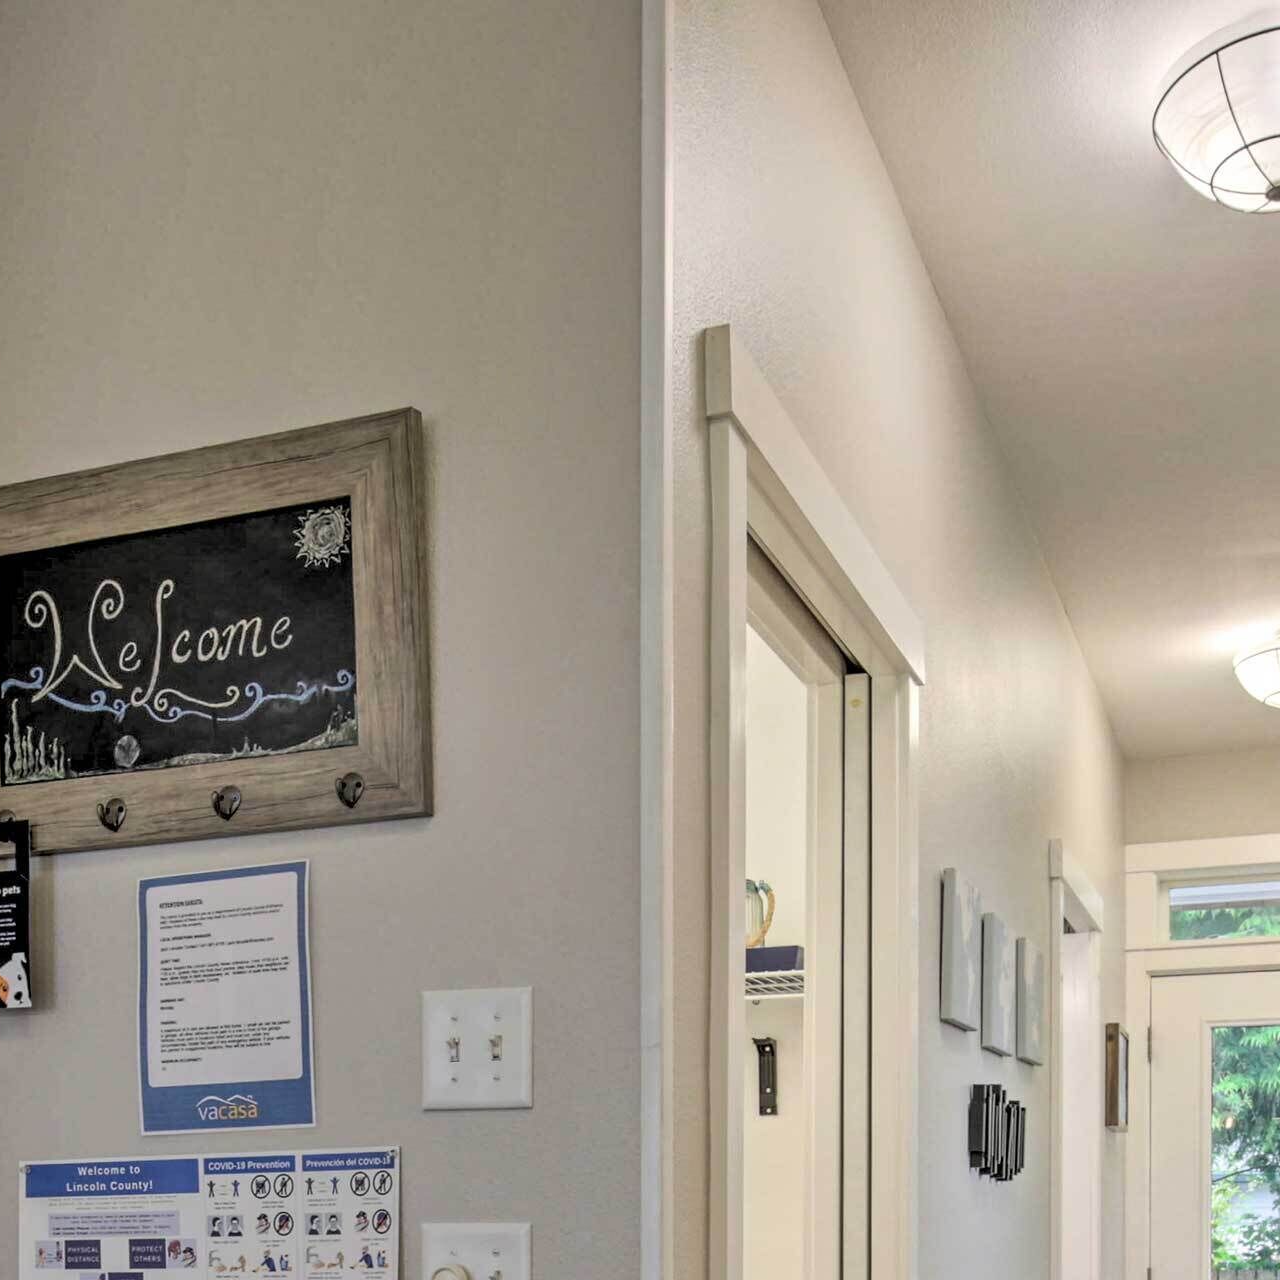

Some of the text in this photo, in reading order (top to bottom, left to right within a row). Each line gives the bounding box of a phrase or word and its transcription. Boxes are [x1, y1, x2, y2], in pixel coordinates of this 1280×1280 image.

[25, 579, 293, 708] Welcome
[2, 886, 21, 897] pets
[198, 1103, 258, 1120] vacasa
[208, 1160, 291, 1171] COVID-19 Prevention
[346, 1157, 357, 1166] del
[77, 1164, 141, 1176] Welcome to
[66, 1179, 153, 1192] Lincoln County!
[67, 1246, 99, 1254] PHYSICAL
[131, 1245, 163, 1253] PROTECT
[67, 1255, 100, 1263] DISTANCE
[133, 1255, 161, 1263] OTHERS
